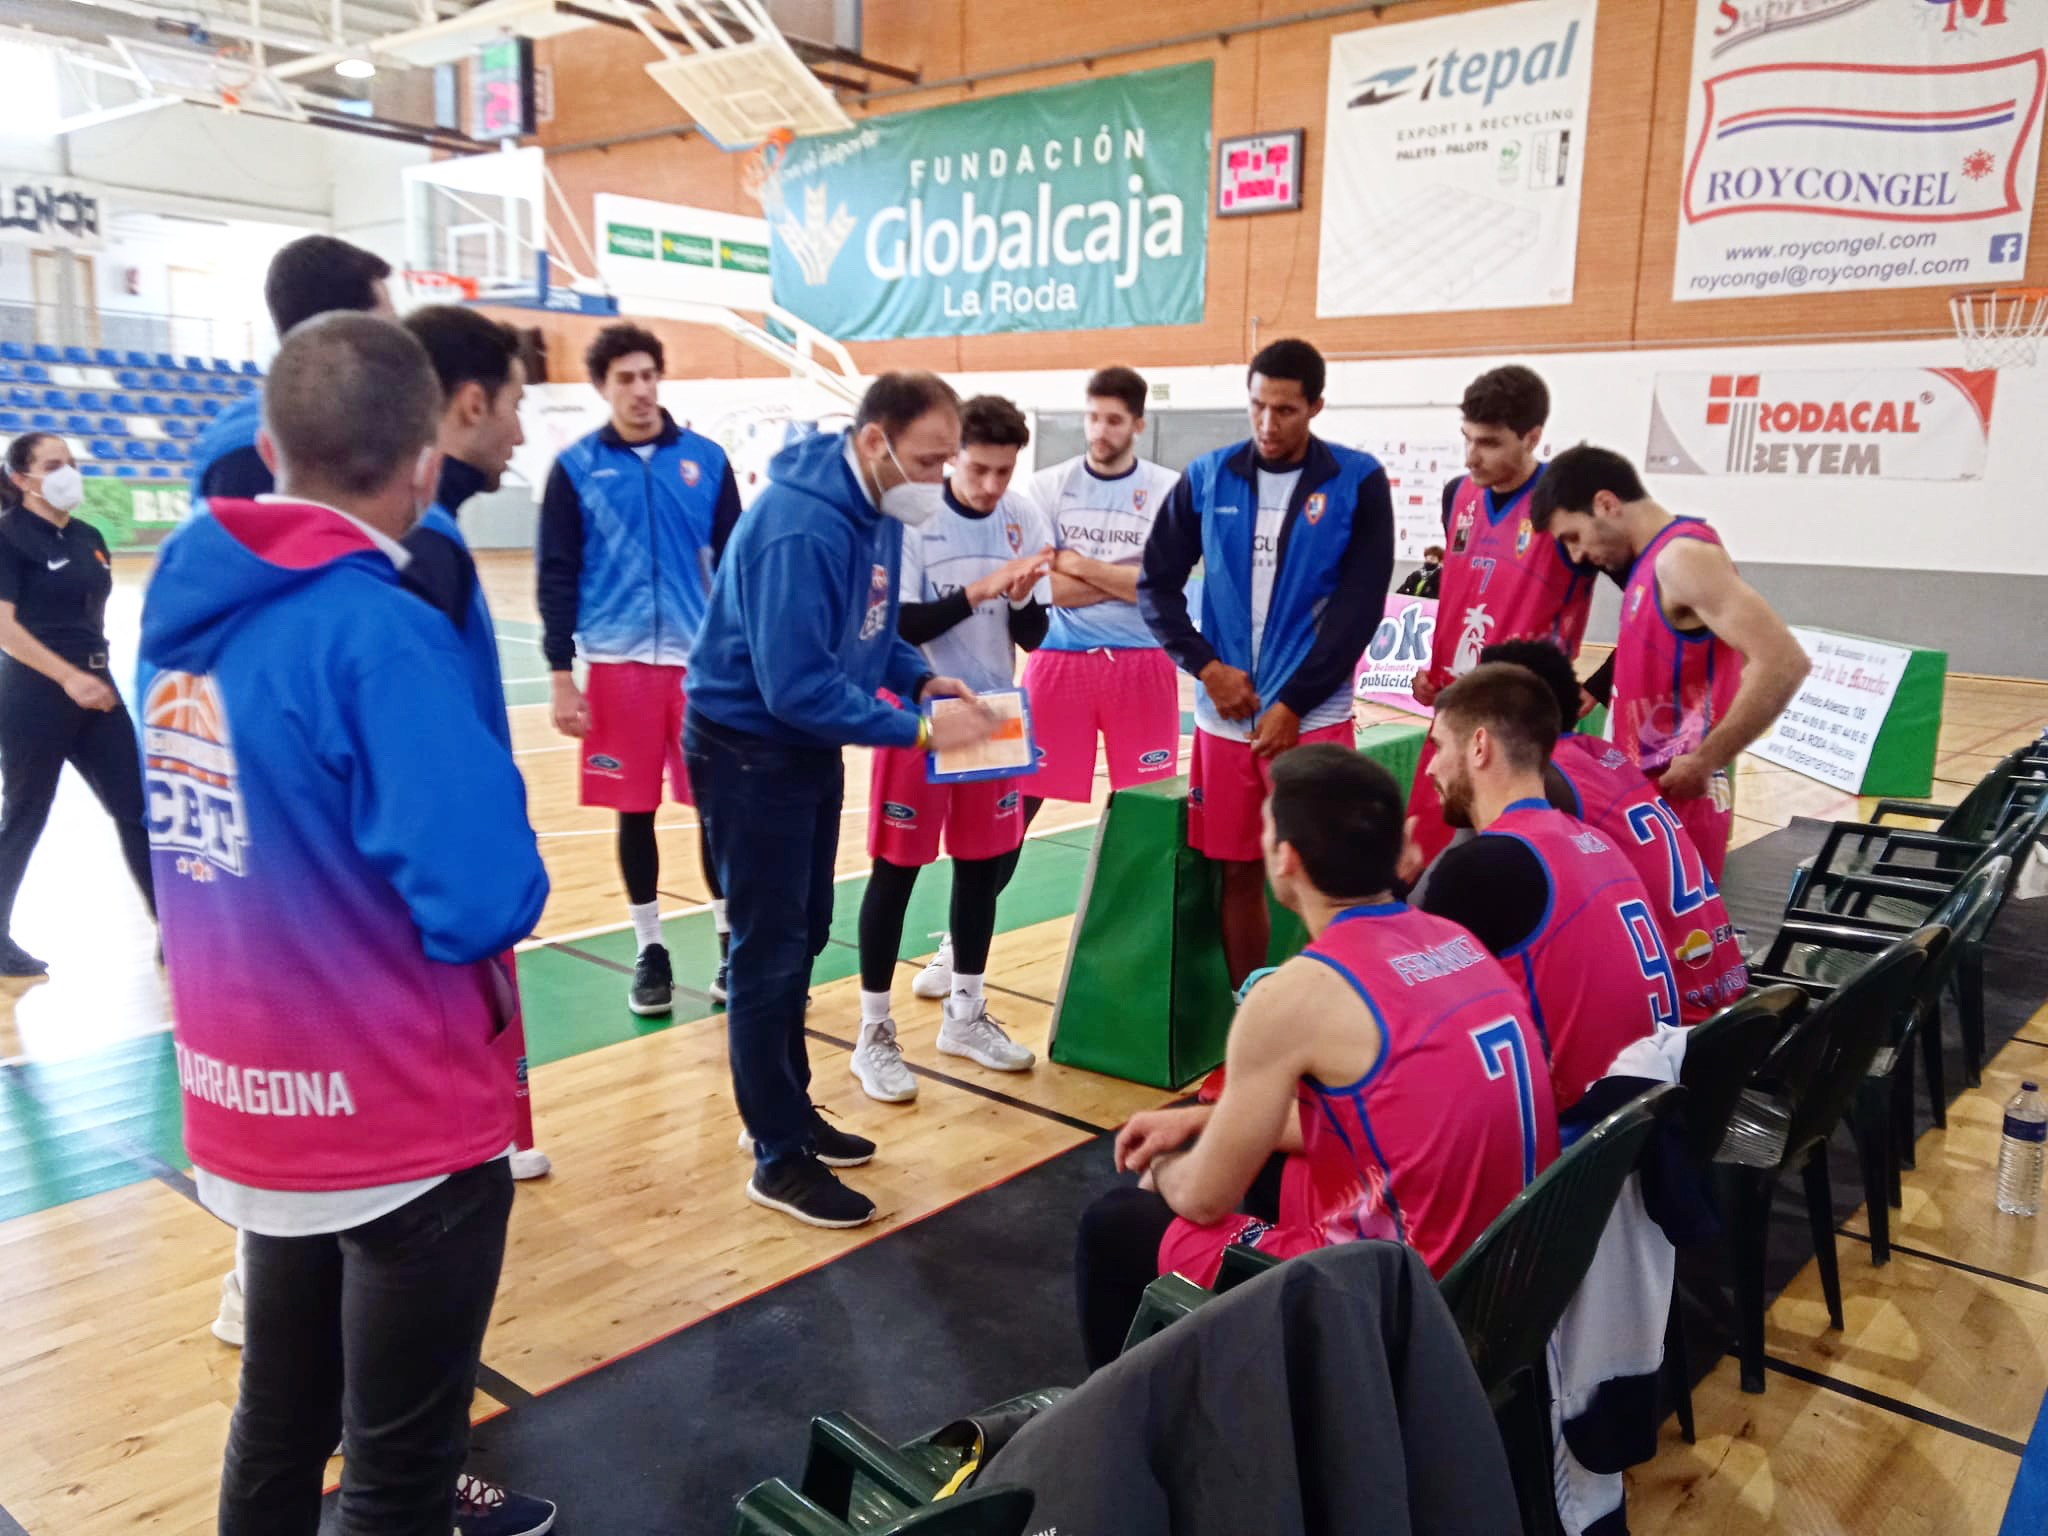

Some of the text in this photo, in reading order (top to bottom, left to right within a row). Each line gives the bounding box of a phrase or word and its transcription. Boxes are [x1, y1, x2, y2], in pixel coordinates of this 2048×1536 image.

[1396, 108, 1575, 142] EXPORT & RECYCLING
[910, 124, 1145, 188] FUNDACIÓN
[1396, 145, 1437, 161] PALETS
[1445, 140, 1489, 156] PALOTS
[1706, 166, 1958, 208] ROYCONGEL
[865, 174, 1185, 289] Globalcaja
[1726, 231, 1938, 261] www.roycongel.com
[1690, 256, 1970, 292] roycongel@roycongel.com
[943, 278, 1078, 318] La Roda
[1617, 899, 1681, 1028] 9
[1468, 1015, 1537, 1188] 7
